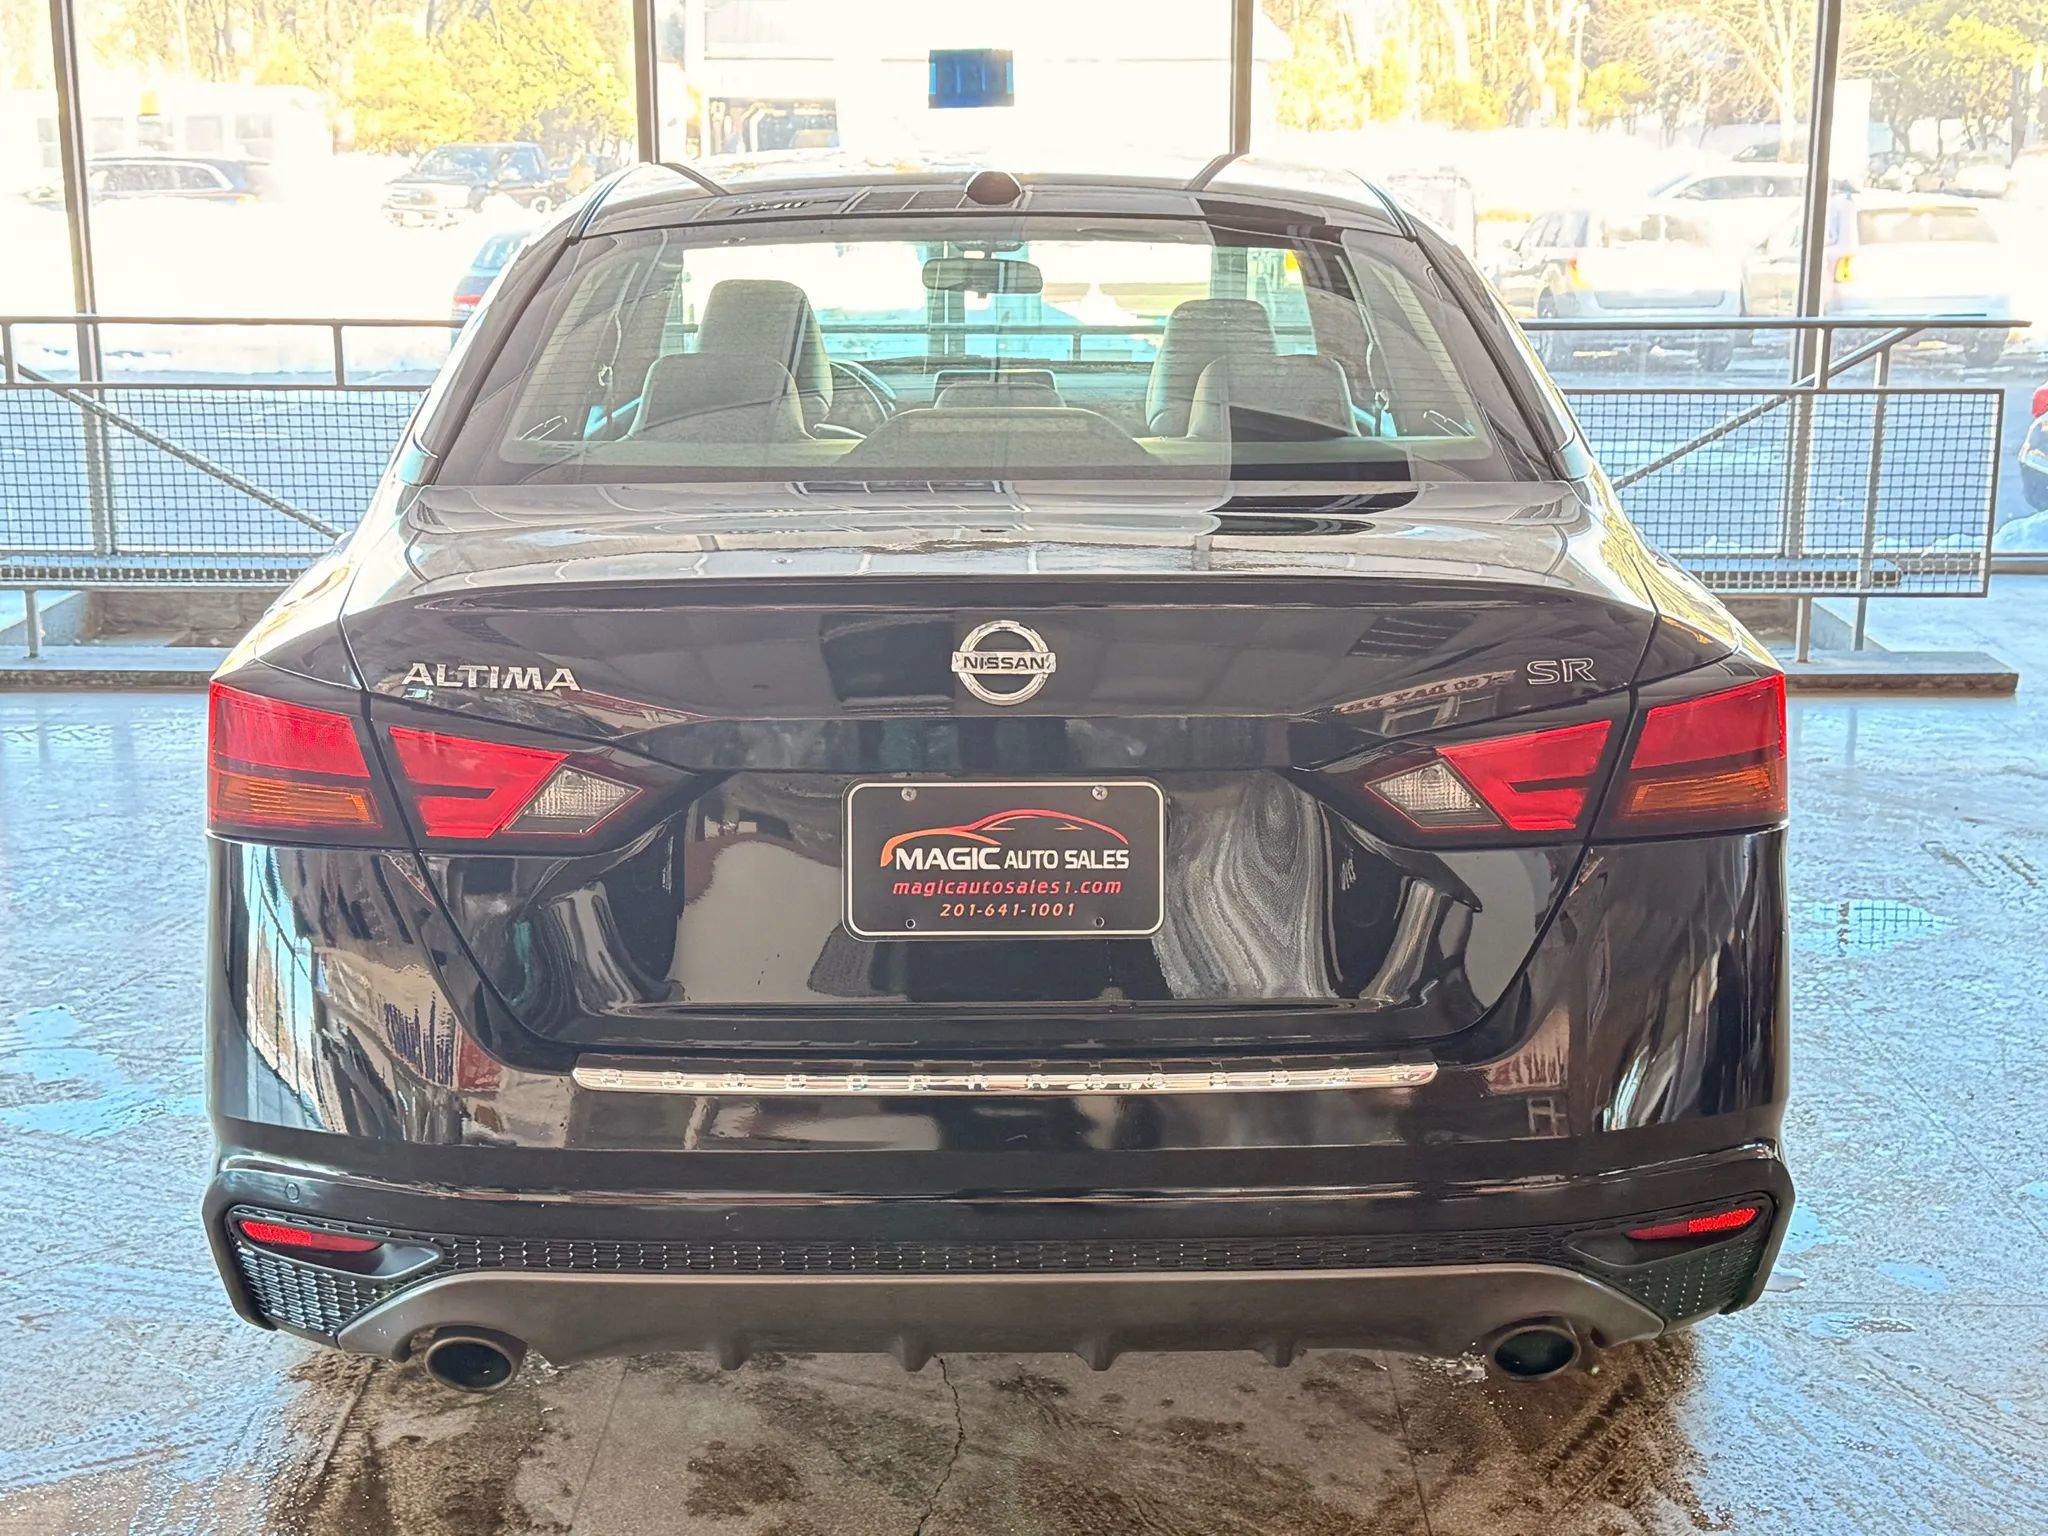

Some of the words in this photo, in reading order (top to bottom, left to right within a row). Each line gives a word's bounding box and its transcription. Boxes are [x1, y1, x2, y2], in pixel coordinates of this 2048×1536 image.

[963, 656, 1046, 670] NISSAN
[1526, 657, 1597, 685] SR
[401, 662, 582, 691] ALTIMA
[895, 847, 1001, 871] MAGIC
[1003, 850, 1059, 870] AUTO
[1063, 850, 1130, 870] SALES
[892, 879, 1122, 897] magicautosales1.com
[939, 902, 1076, 918] 201-641-1001
